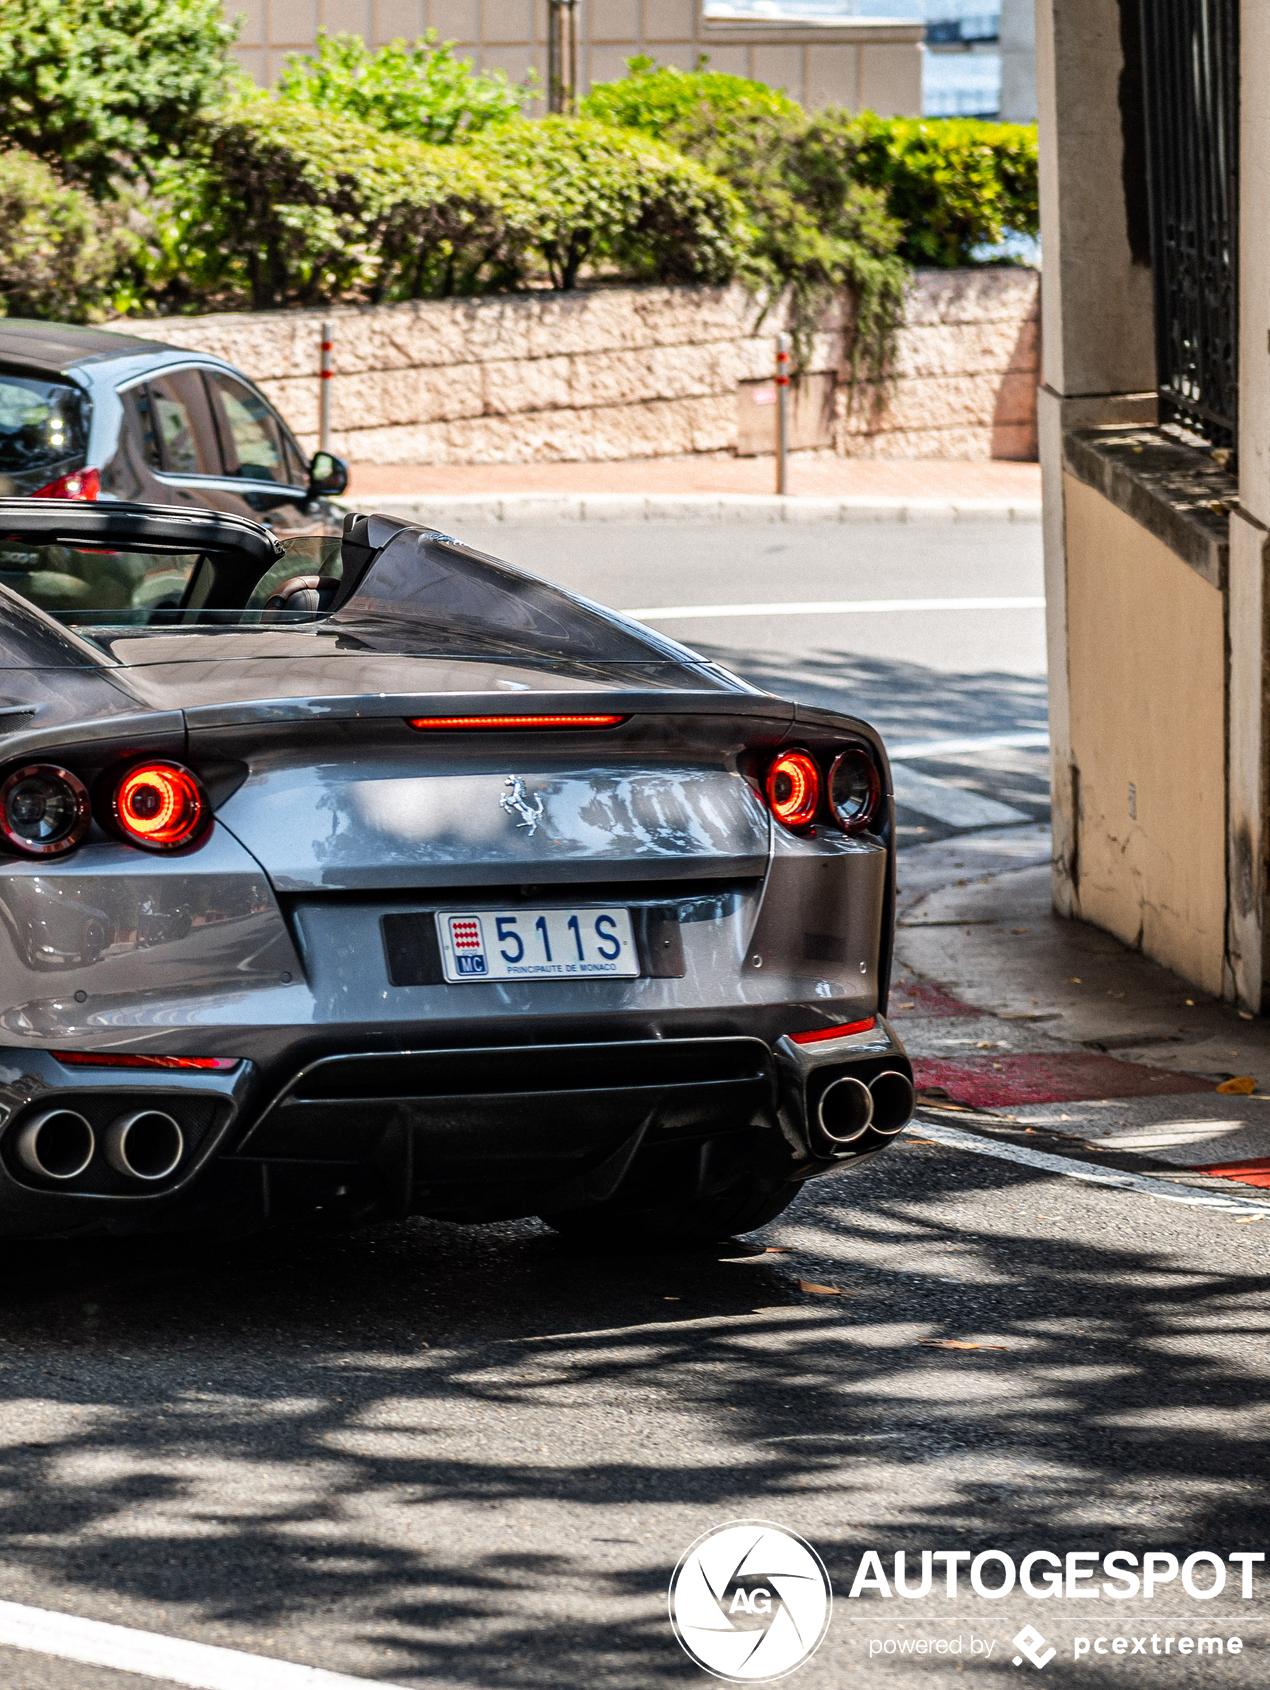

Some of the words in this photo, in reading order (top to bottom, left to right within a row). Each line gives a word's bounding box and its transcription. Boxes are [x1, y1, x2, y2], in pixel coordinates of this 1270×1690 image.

[495, 914, 621, 963] 511S
[461, 957, 483, 971] MC
[507, 964, 564, 974] PRINCIPAUTE
[566, 964, 578, 972] DE
[580, 963, 617, 972] MONACO
